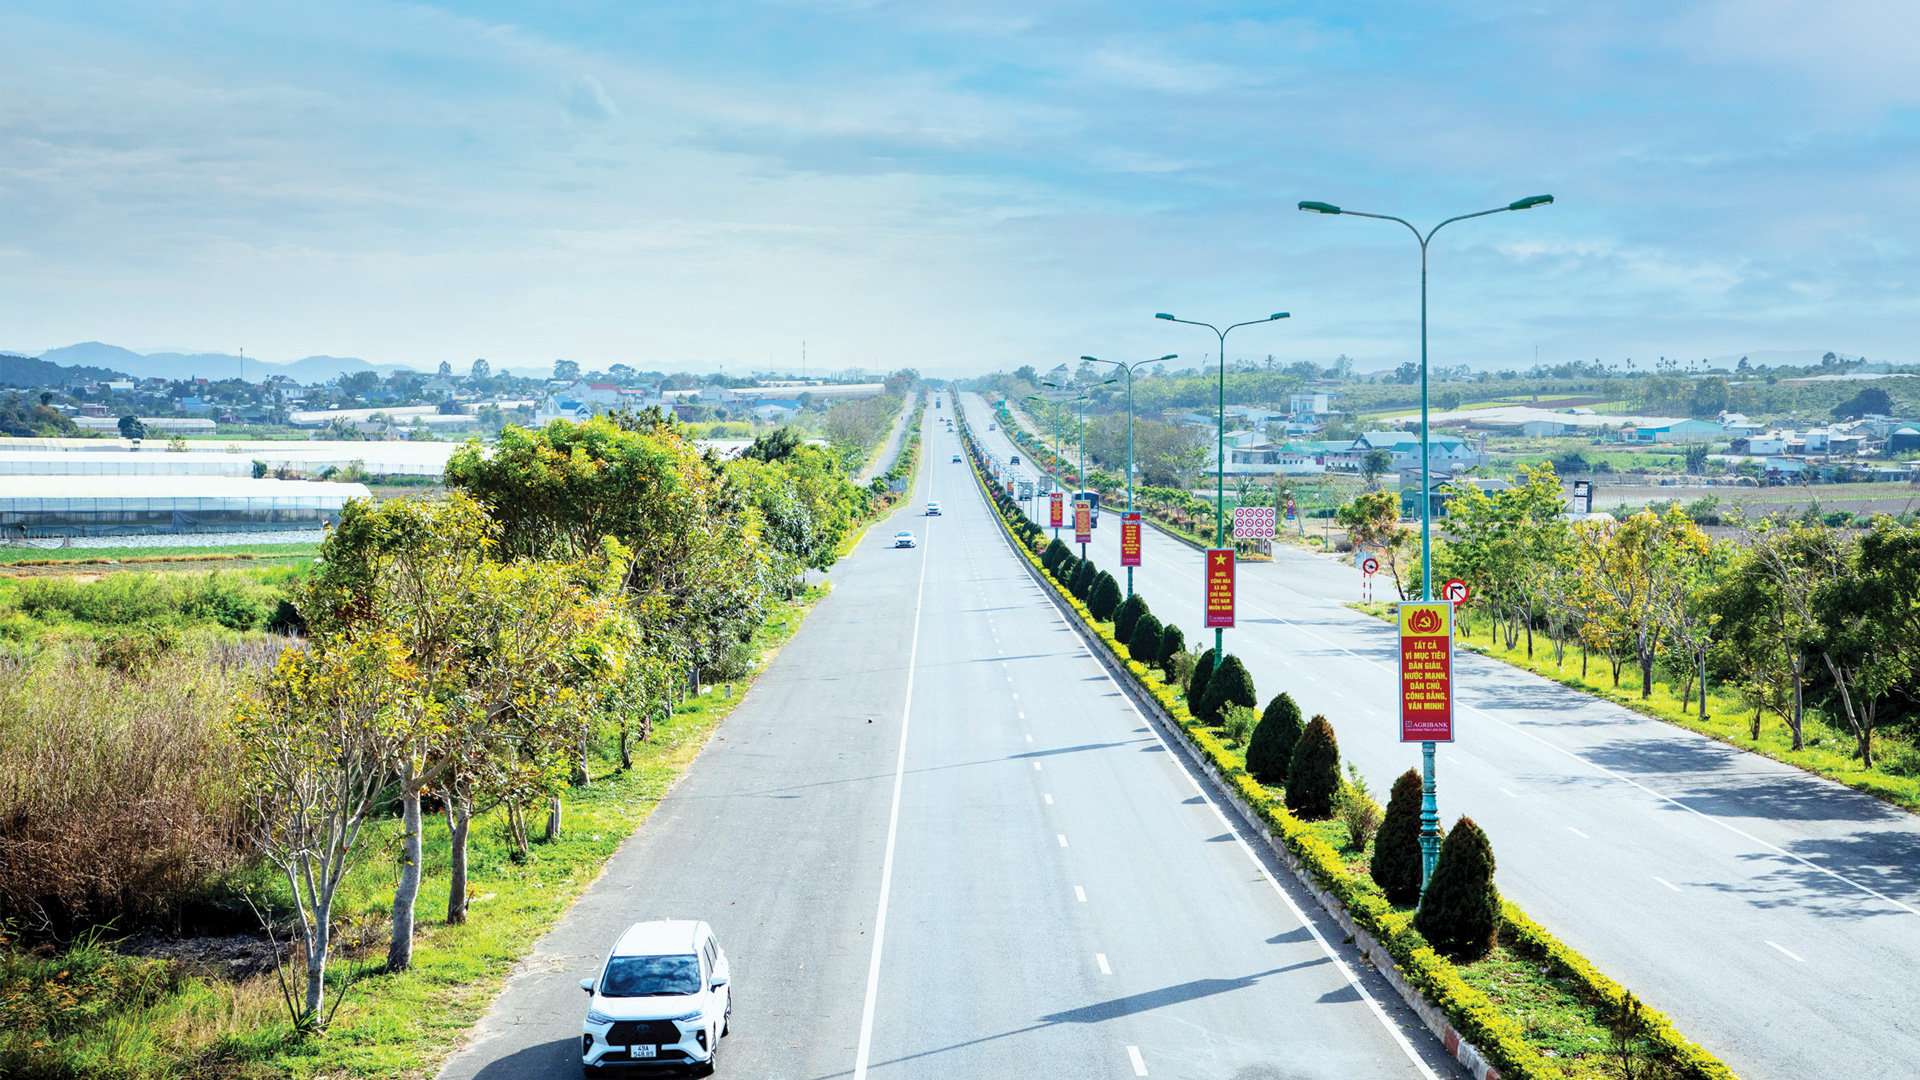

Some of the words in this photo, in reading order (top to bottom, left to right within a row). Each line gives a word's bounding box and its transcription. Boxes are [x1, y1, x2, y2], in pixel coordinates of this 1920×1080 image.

[1414, 640, 1426, 649] TẤT
[1428, 640, 1437, 649] CẢ
[1405, 651, 1412, 660] VÌ
[1414, 652, 1430, 661] MỤC
[1431, 651, 1446, 660] TIÊU
[1408, 661, 1423, 670] DÂN
[1424, 661, 1443, 670] GIÀU,
[1404, 671, 1423, 680] NƯỚC
[1425, 672, 1448, 681] MẠNH,
[1410, 681, 1424, 690] DÂN
[1426, 680, 1442, 690] CHỦ,
[1406, 691, 1424, 700] CÔNG
[1426, 690, 1447, 700] BẰNG,
